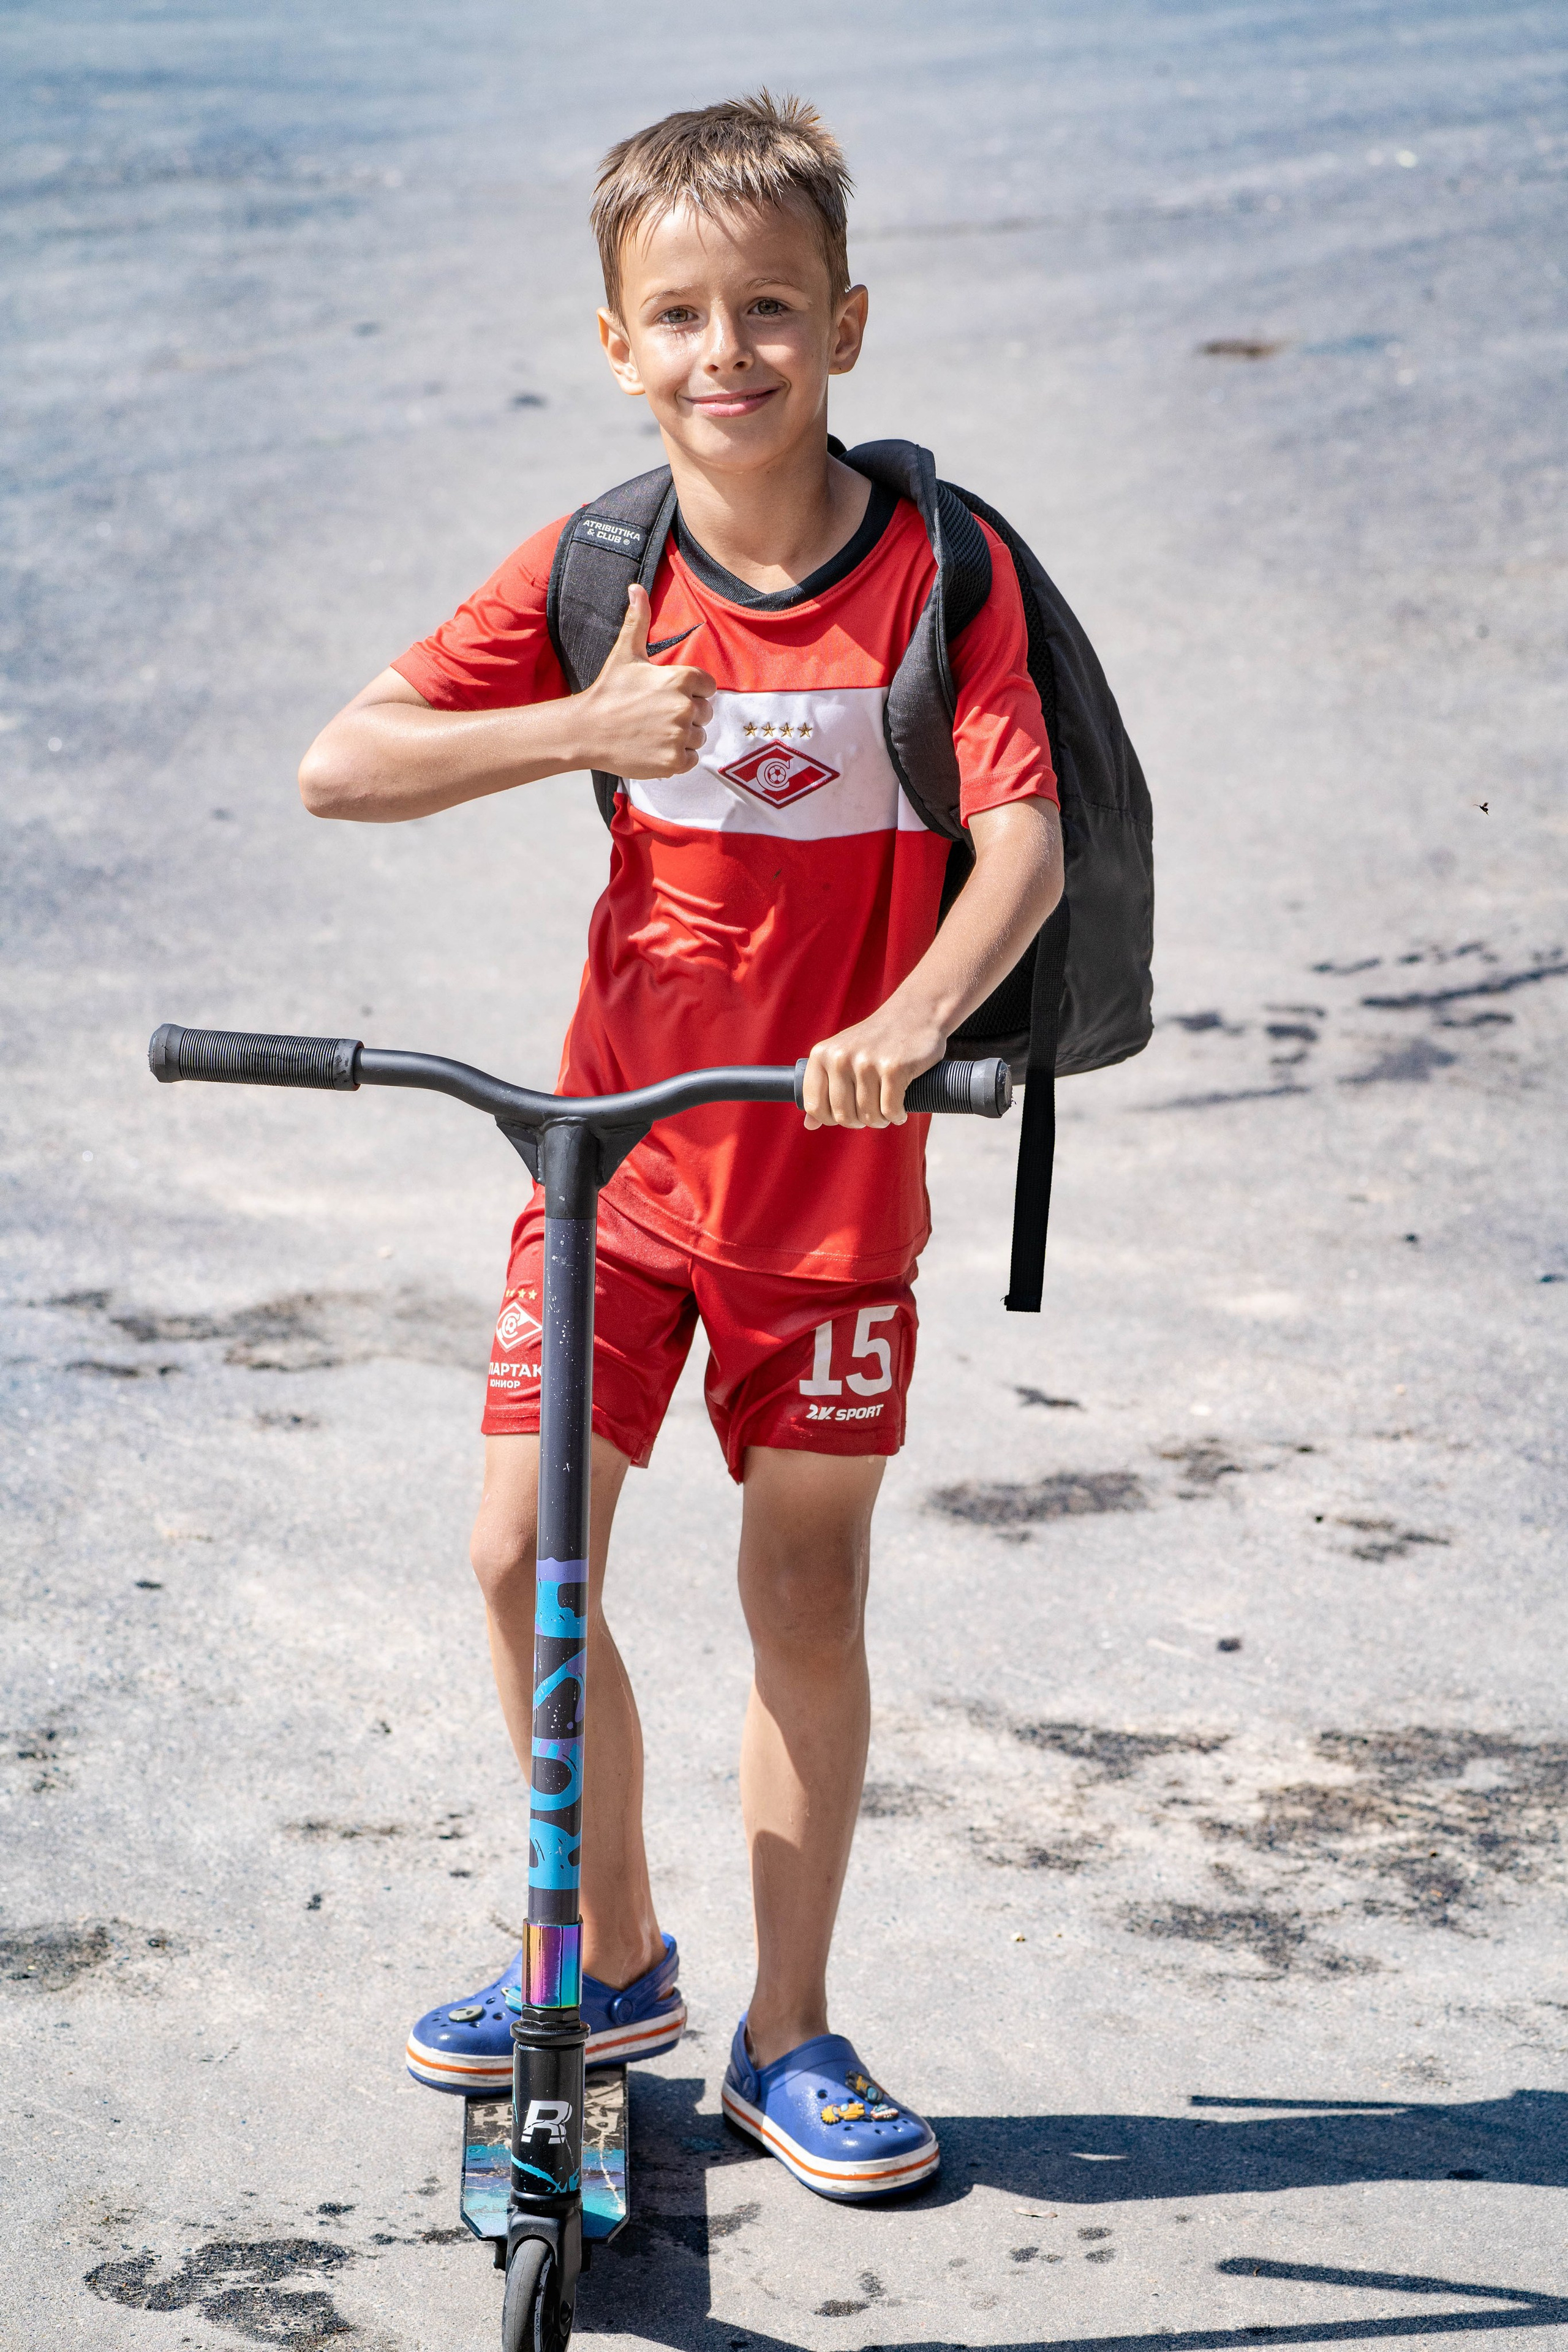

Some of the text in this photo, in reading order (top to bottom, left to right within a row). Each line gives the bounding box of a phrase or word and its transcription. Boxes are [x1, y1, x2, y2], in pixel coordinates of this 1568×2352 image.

[582, 519, 640, 541] ATRIBUTIKA
[597, 531, 622, 543] CLUB
[799, 1305, 899, 1396] 15
[805, 1404, 884, 1421] 2K SPORT
[521, 2100, 573, 2144] R
